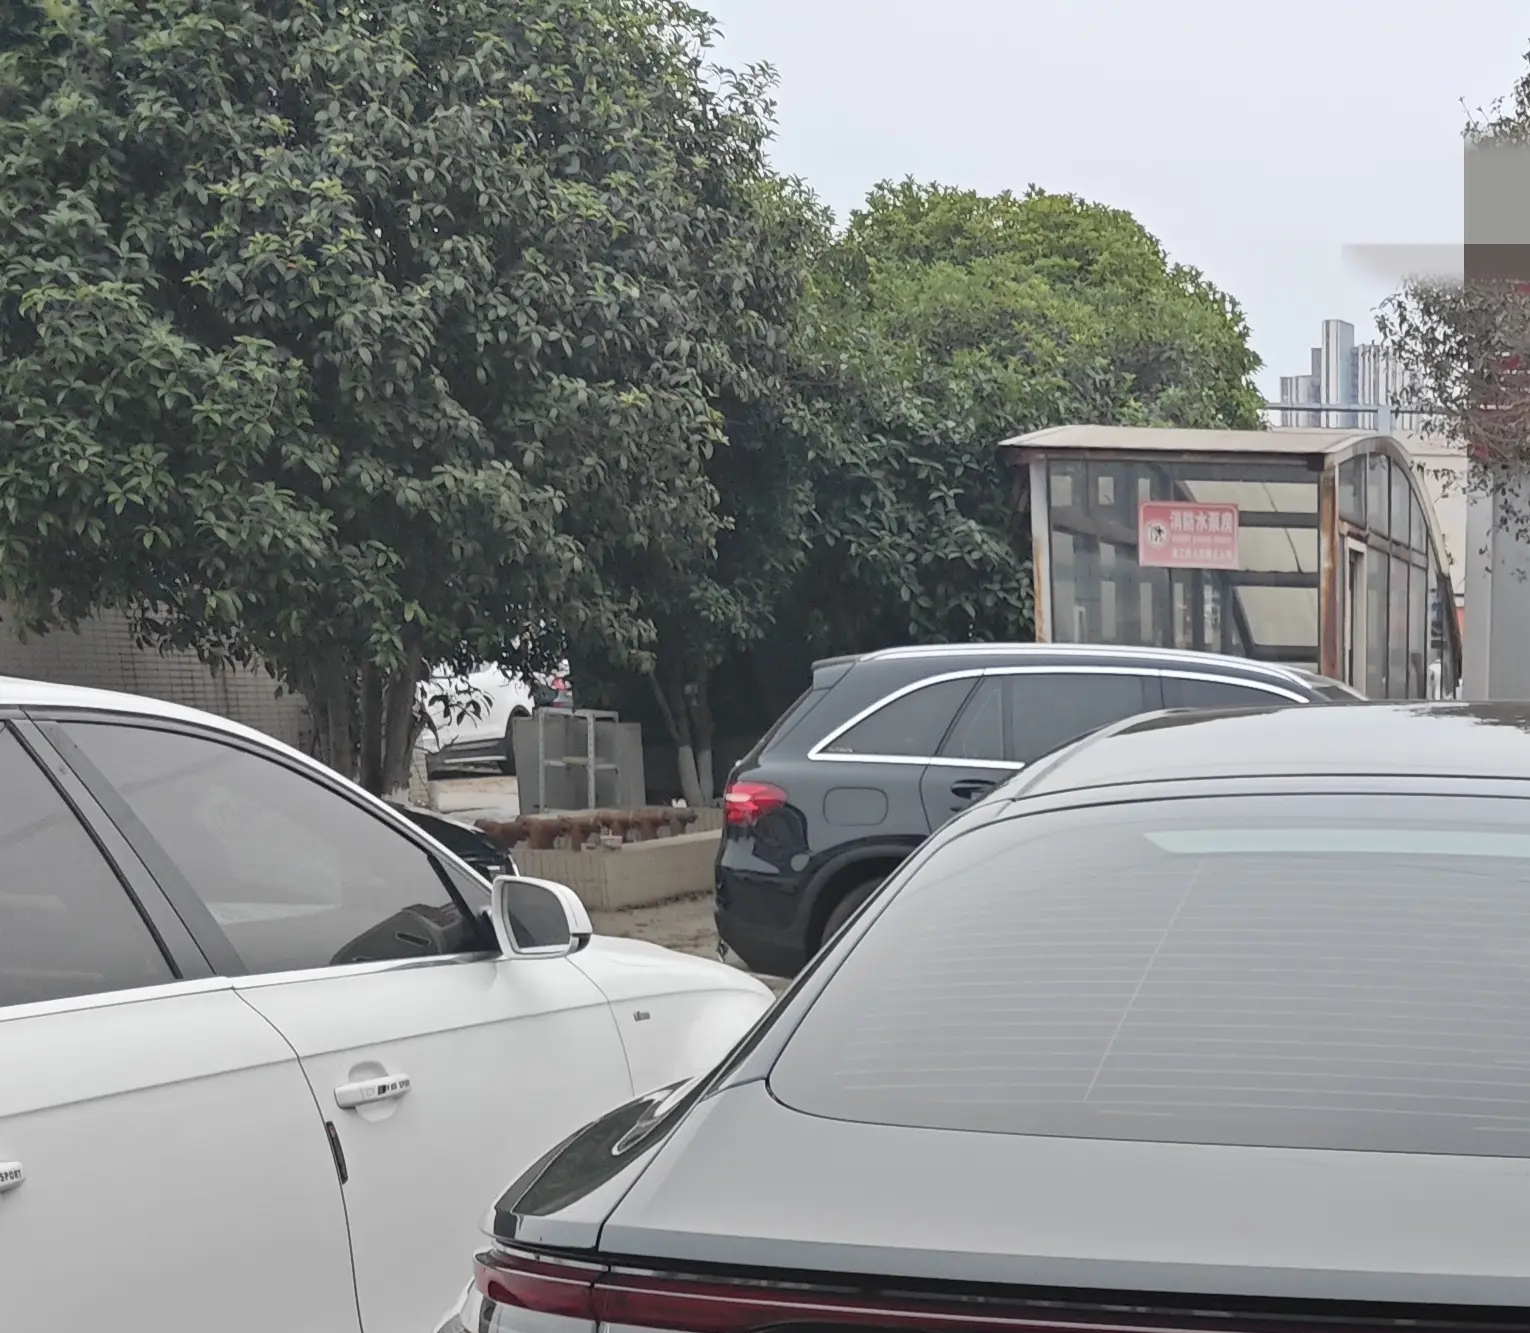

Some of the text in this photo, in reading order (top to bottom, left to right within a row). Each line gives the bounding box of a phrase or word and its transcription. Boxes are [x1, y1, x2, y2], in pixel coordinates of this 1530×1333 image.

[1170, 510, 1232, 533] 消防水泵房
